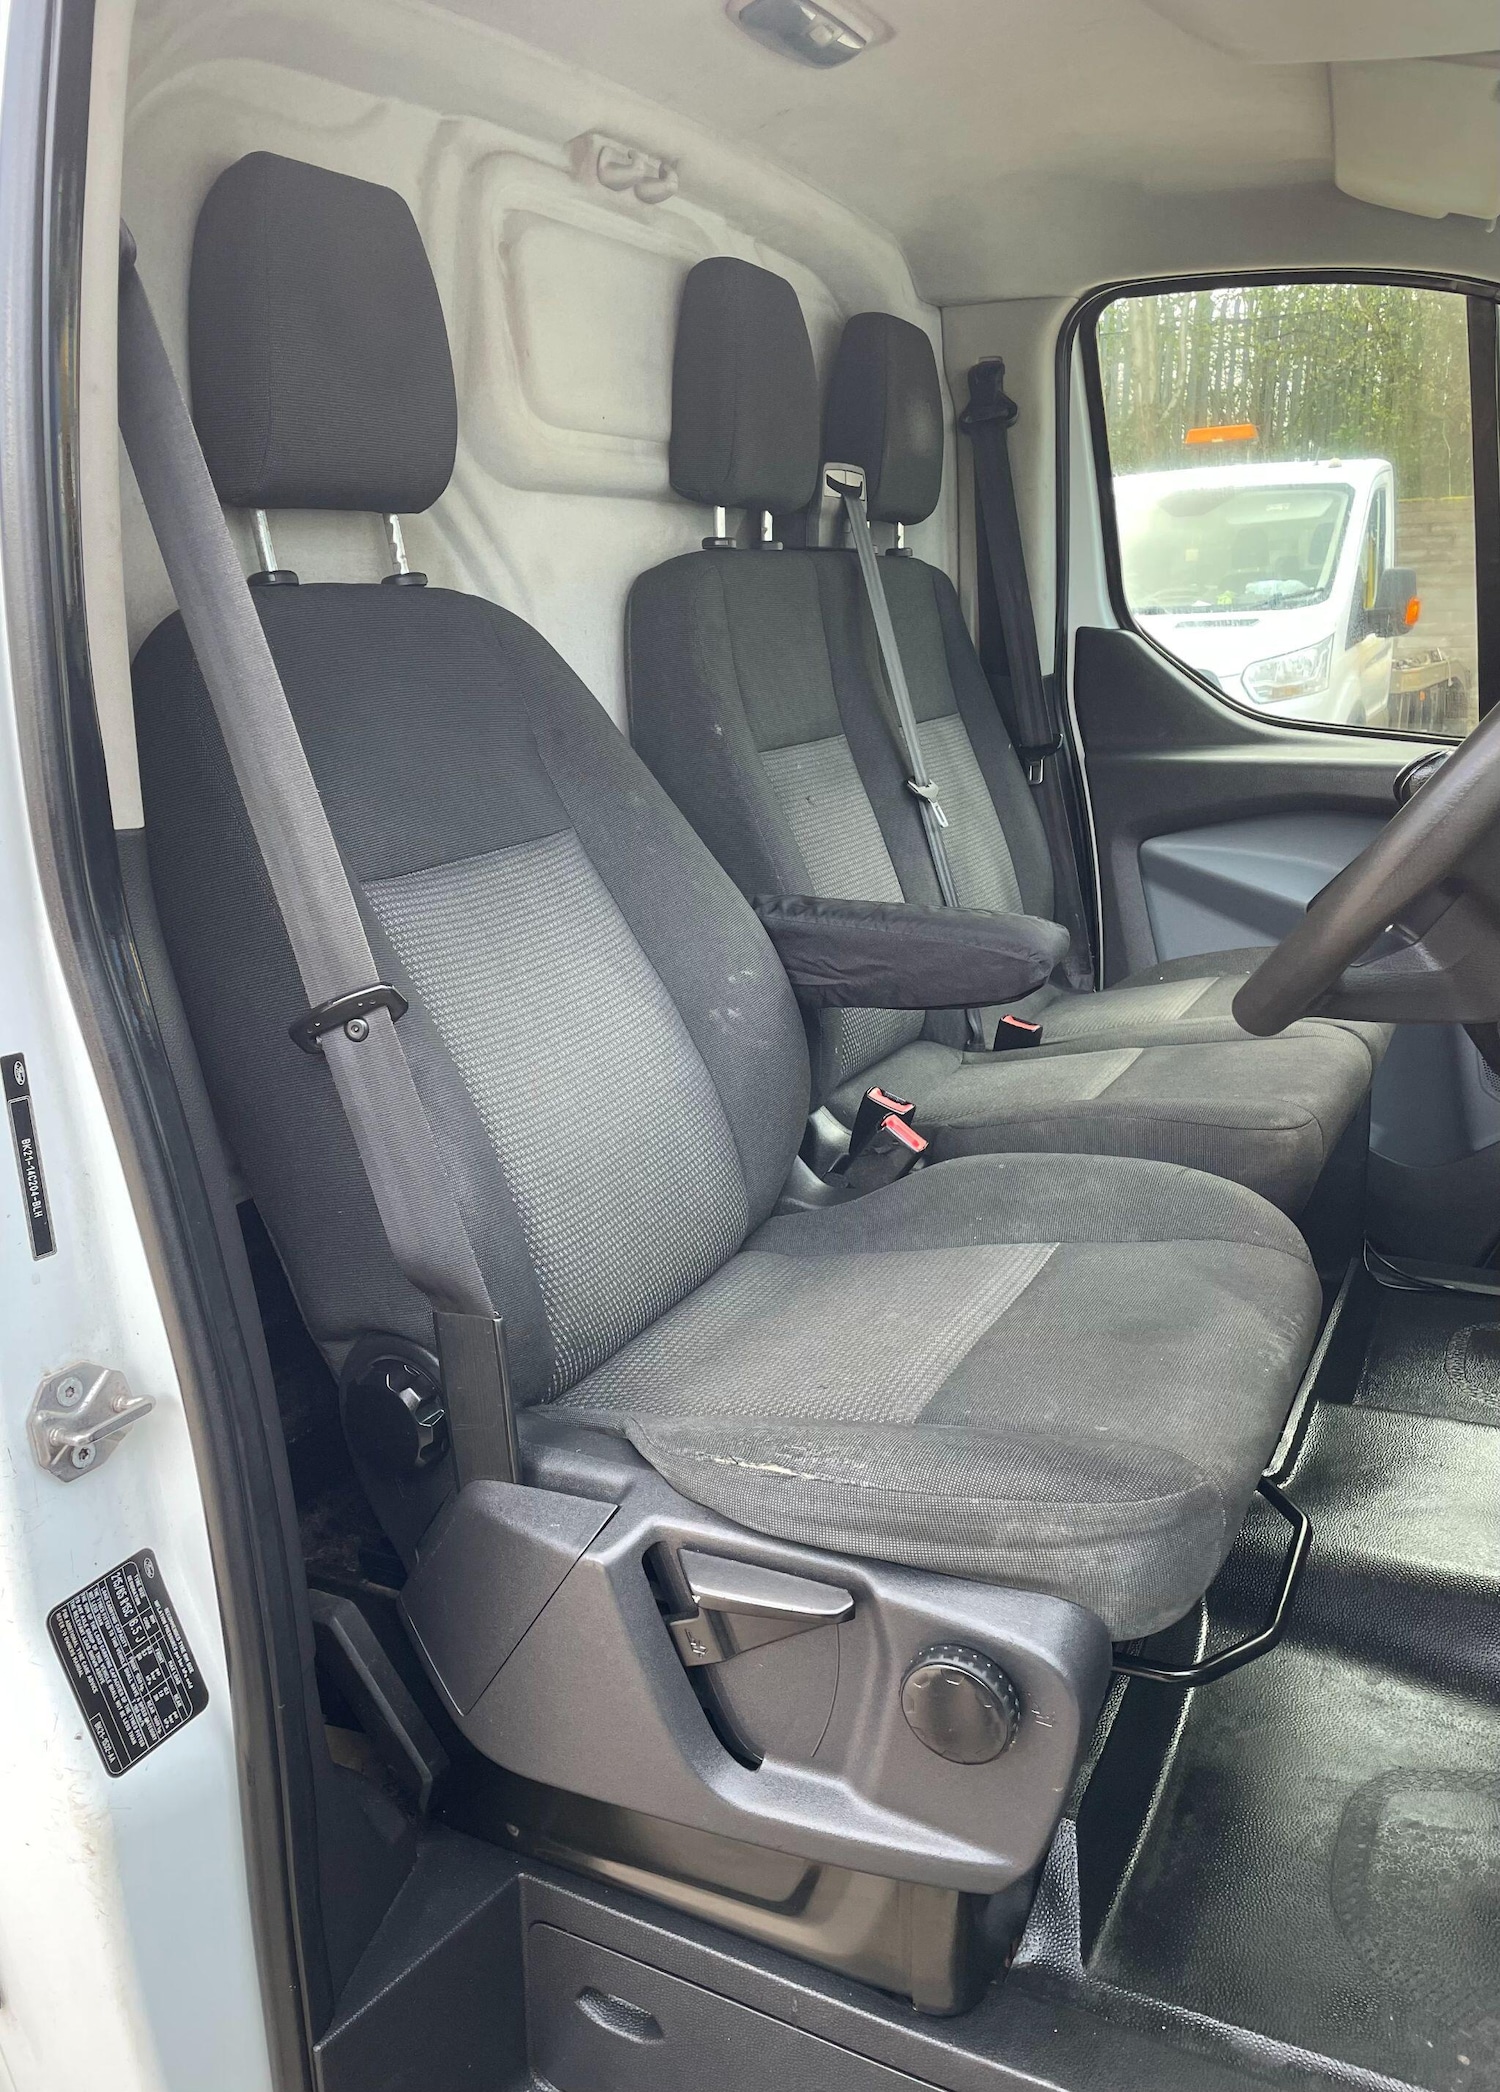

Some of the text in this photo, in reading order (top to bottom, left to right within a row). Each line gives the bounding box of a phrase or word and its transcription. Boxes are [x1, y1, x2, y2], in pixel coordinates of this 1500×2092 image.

[21, 1138, 43, 1218] BK21-14C204-BLH
[118, 1595, 134, 1618] R15C
[128, 1617, 142, 1636] 6.5
